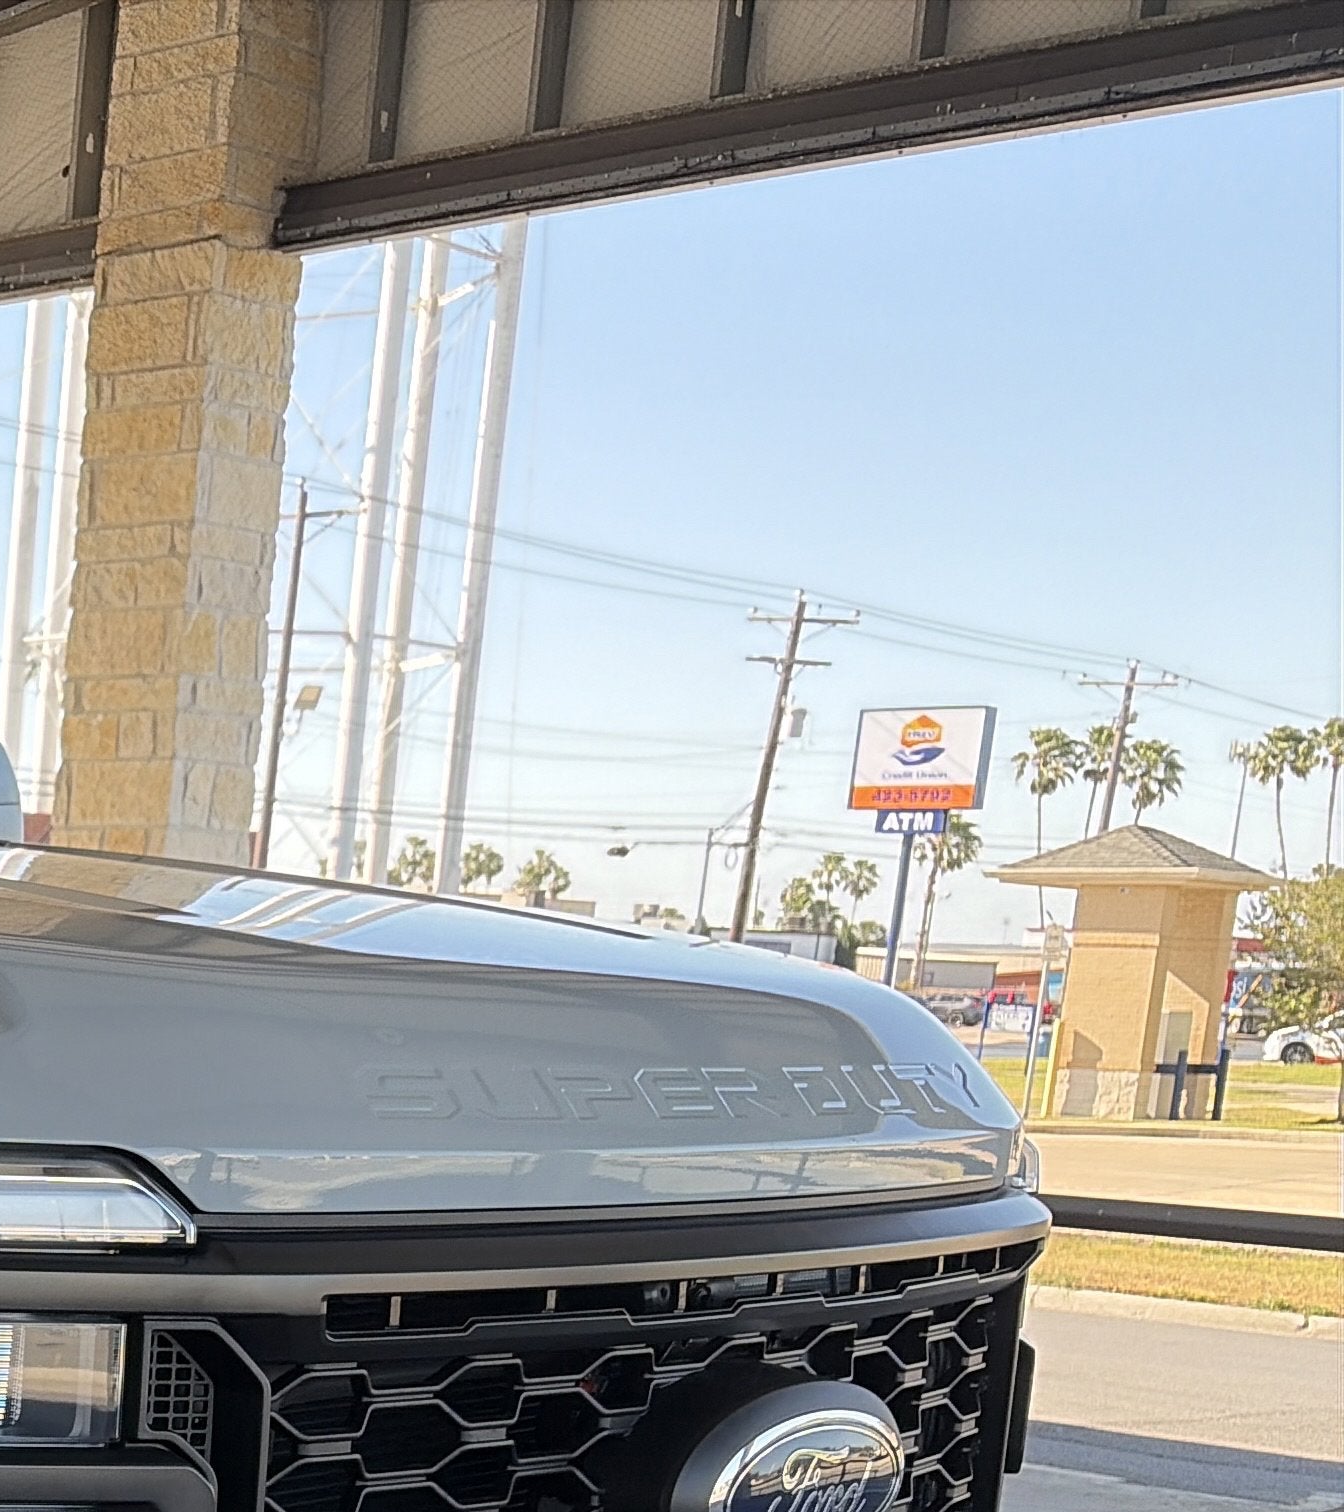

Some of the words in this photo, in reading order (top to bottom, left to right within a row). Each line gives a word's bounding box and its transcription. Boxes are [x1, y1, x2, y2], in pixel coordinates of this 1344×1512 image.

[882, 811, 934, 831] ATM
[365, 1064, 786, 1122] SUPER
[781, 1062, 980, 1116] DUTY
